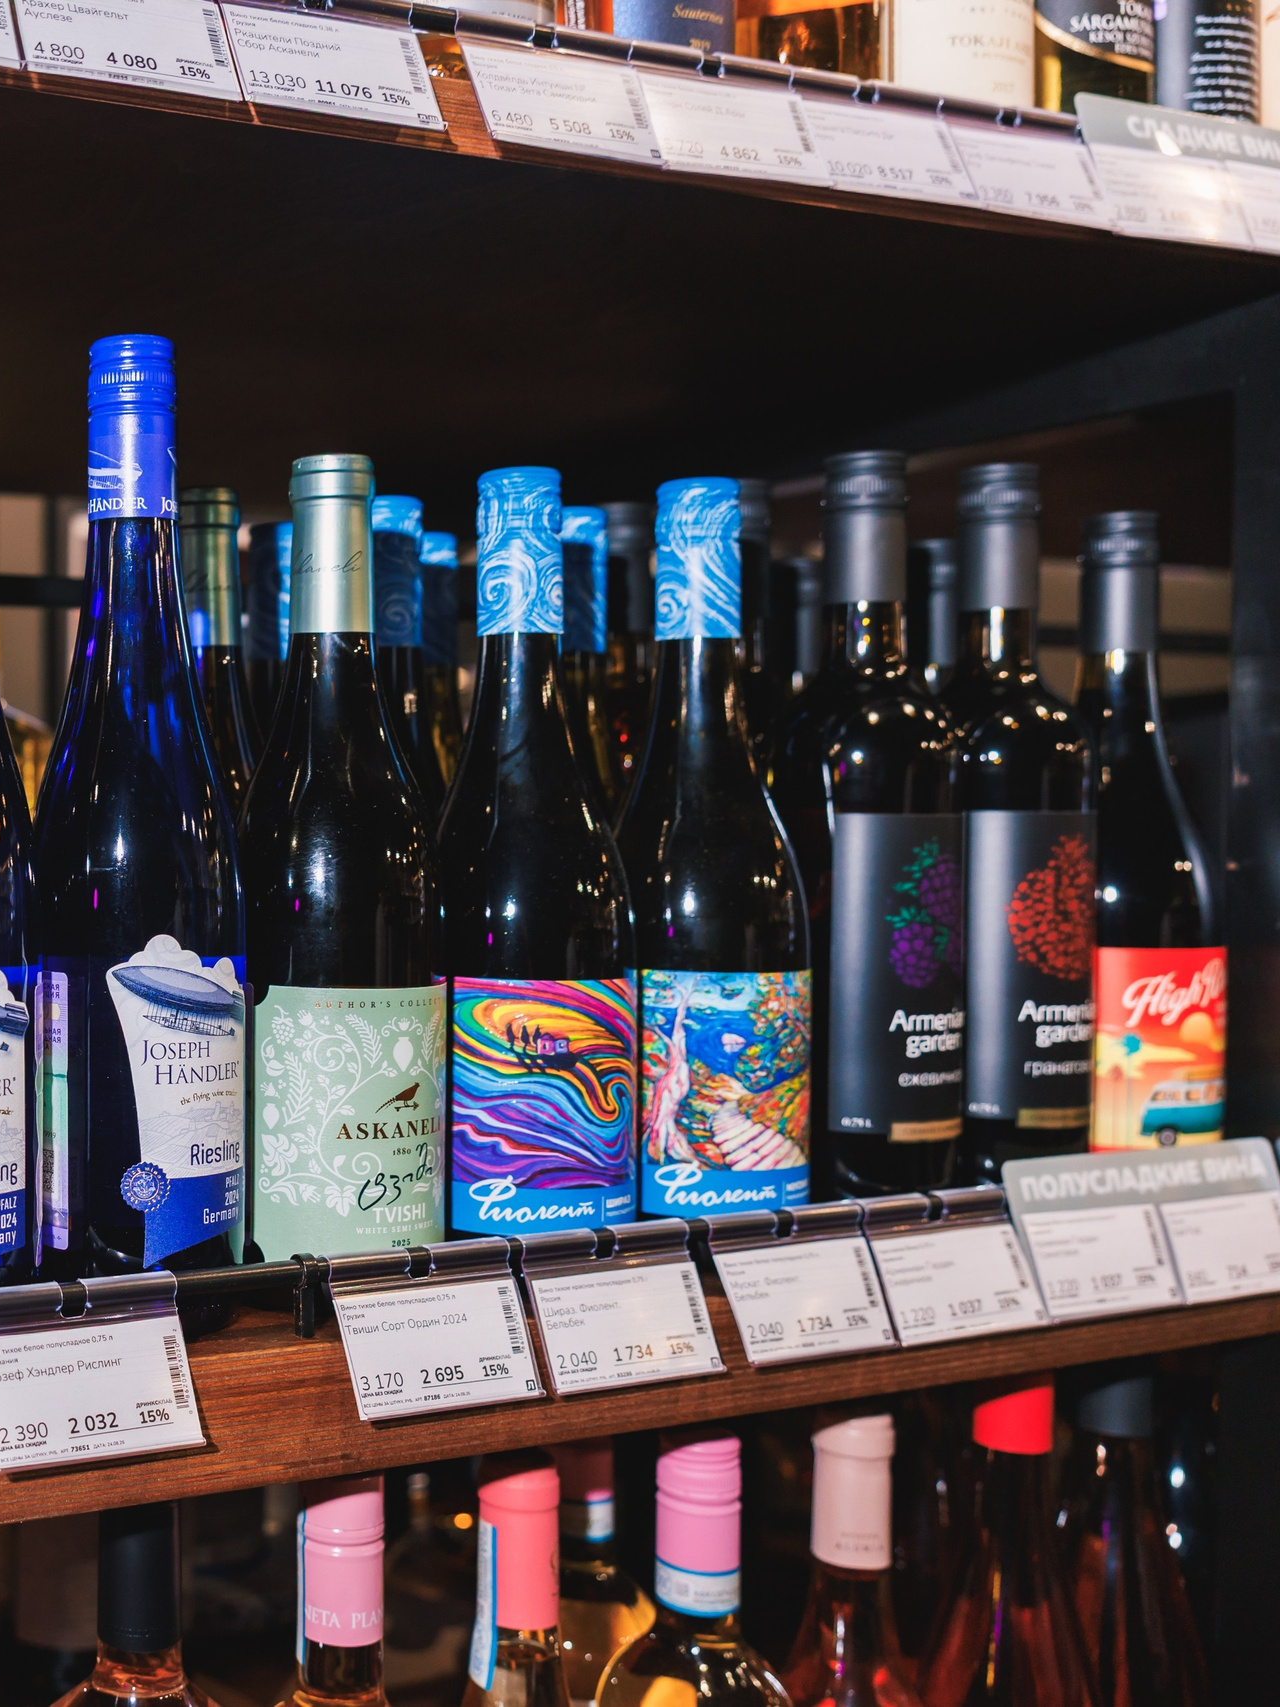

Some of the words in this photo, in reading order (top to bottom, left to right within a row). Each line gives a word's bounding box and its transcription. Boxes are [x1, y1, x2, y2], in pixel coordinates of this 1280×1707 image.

[24, 9, 73, 23] Ауслезе
[68, 3, 129, 21] Цвайгельт
[234, 27, 292, 45] Ркацители
[294, 36, 342, 52] Поздний
[237, 38, 266, 51] Сбор
[268, 44, 320, 59] Асканели
[34, 42, 45, 55] 4
[50, 43, 85, 60] 800
[106, 52, 118, 65] 4
[123, 54, 157, 71] 080
[180, 65, 211, 80] 15%
[250, 70, 270, 84] 13
[274, 73, 308, 90] 030
[316, 79, 337, 95] 11
[340, 83, 373, 100] 076
[381, 92, 411, 107] 15%
[506, 112, 533, 127] 480
[564, 120, 591, 135] 508
[609, 128, 634, 141] 15%
[732, 147, 760, 161] 862
[314, 1000, 392, 1009] AUTHOR'S
[141, 1039, 211, 1067] JOSEPH
[154, 1061, 239, 1085] HÄNDLER
[192, 1091, 211, 1105] flying
[190, 1139, 240, 1166] Riesling
[392, 1148, 412, 1156] 1880
[225, 1173, 240, 1186] PFALZ
[224, 1191, 240, 1207] 2024
[203, 1205, 239, 1225] Germany
[372, 1202, 426, 1224] TVISHI
[356, 1226, 388, 1235] WHITE
[391, 1223, 412, 1233] SEMI
[391, 1238, 411, 1248] 2025
[340, 1304, 357, 1312] Вино
[358, 1301, 376, 1310] тихое
[377, 1299, 396, 1308] белое
[397, 1295, 436, 1306] полусладкое
[342, 1313, 365, 1322] Грузия
[345, 1323, 380, 1336] Твиши
[381, 1320, 406, 1334] Сорт
[407, 1317, 441, 1331] Ордин
[442, 1313, 468, 1325] 2024
[546, 1318, 586, 1330] Бельбек
[759, 1321, 784, 1337] 040
[808, 1315, 833, 1330] 734
[1, 1346, 22, 1356] тихое
[23, 1343, 44, 1353] белое
[45, 1337, 91, 1350] полусладкое
[557, 1354, 567, 1369] 2
[569, 1350, 598, 1367] 040
[613, 1347, 623, 1362] 1
[625, 1343, 653, 1360] 734
[669, 1341, 695, 1355] 15%
[26, 1364, 75, 1379] Хэндлер
[77, 1356, 123, 1371] Рислинг
[478, 1353, 511, 1363] ДРИНКСКЛАБ
[360, 1375, 371, 1391] 3
[376, 1371, 404, 1390] 170
[420, 1368, 431, 1384] 2
[434, 1364, 464, 1382] 695
[481, 1362, 509, 1378] 15%
[135, 1398, 173, 1409] ДРИНКСКЛАБ
[0, 1427, 11, 1444] 2
[15, 1421, 49, 1442] 390
[68, 1417, 80, 1434] 2
[84, 1411, 119, 1432] 032
[139, 1408, 170, 1424] 15%
[70, 1444, 90, 1453] 73651
